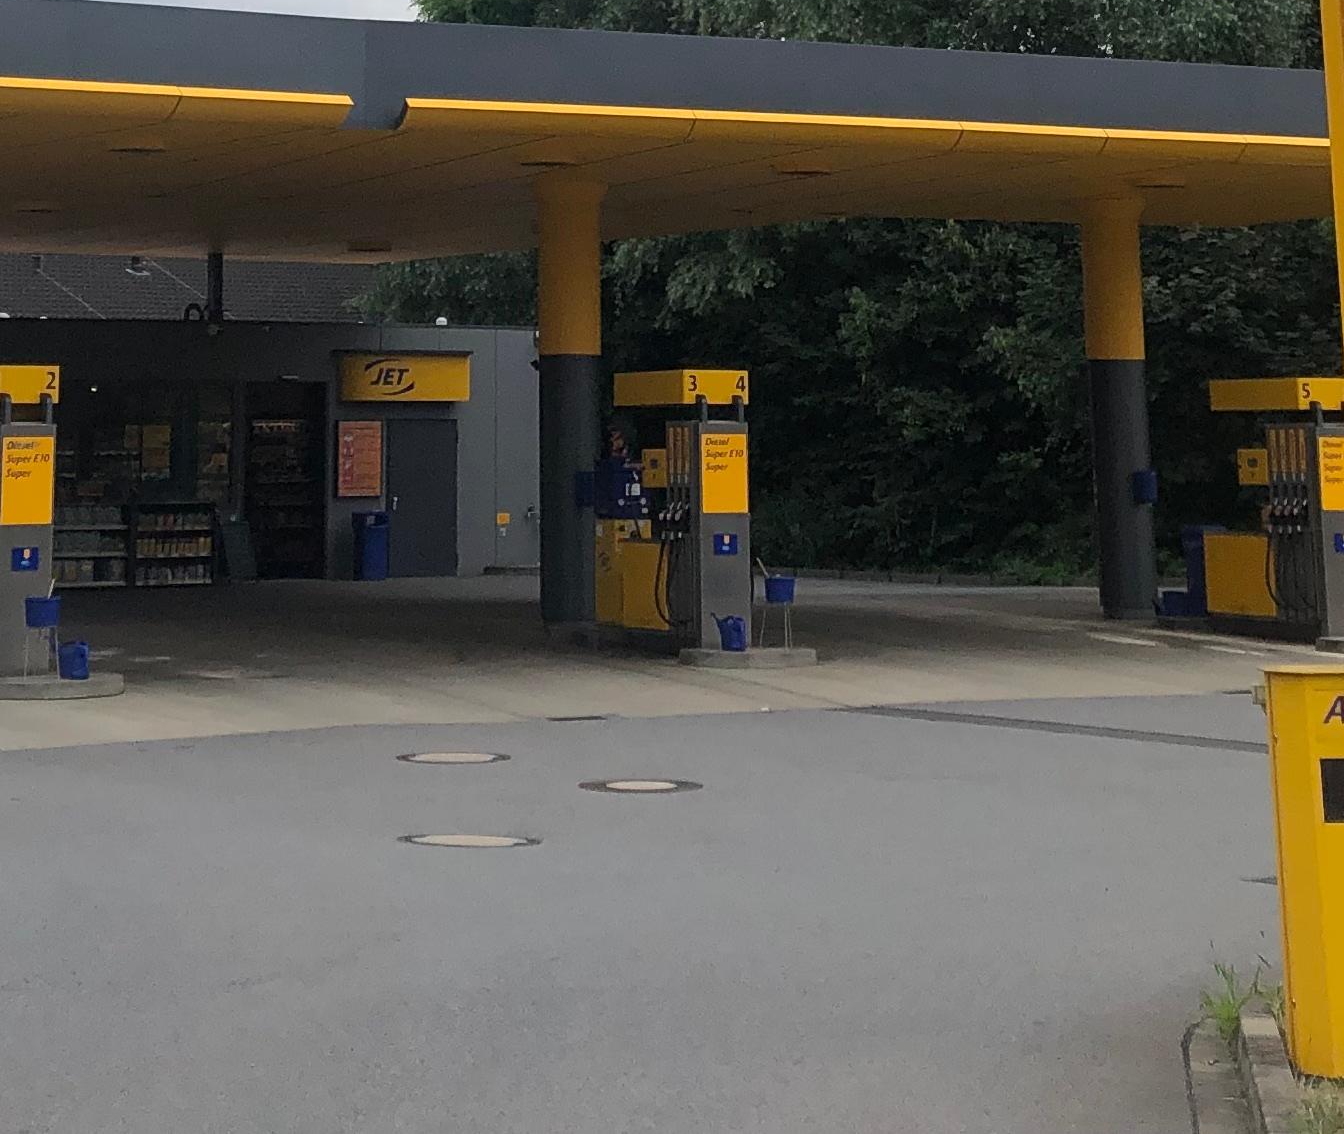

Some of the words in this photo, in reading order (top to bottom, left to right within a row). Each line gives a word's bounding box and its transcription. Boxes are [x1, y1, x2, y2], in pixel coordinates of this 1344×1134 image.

[46, 372, 57, 390] 2
[370, 368, 410, 386] JET
[688, 375, 698, 392] 3
[735, 375, 746, 392] 4
[1301, 383, 1311, 399] 5
[6, 454, 31, 465] Super
[33, 453, 50, 463] E10
[705, 449, 728, 460] Super
[729, 449, 744, 457] E10
[6, 468, 32, 479] Super
